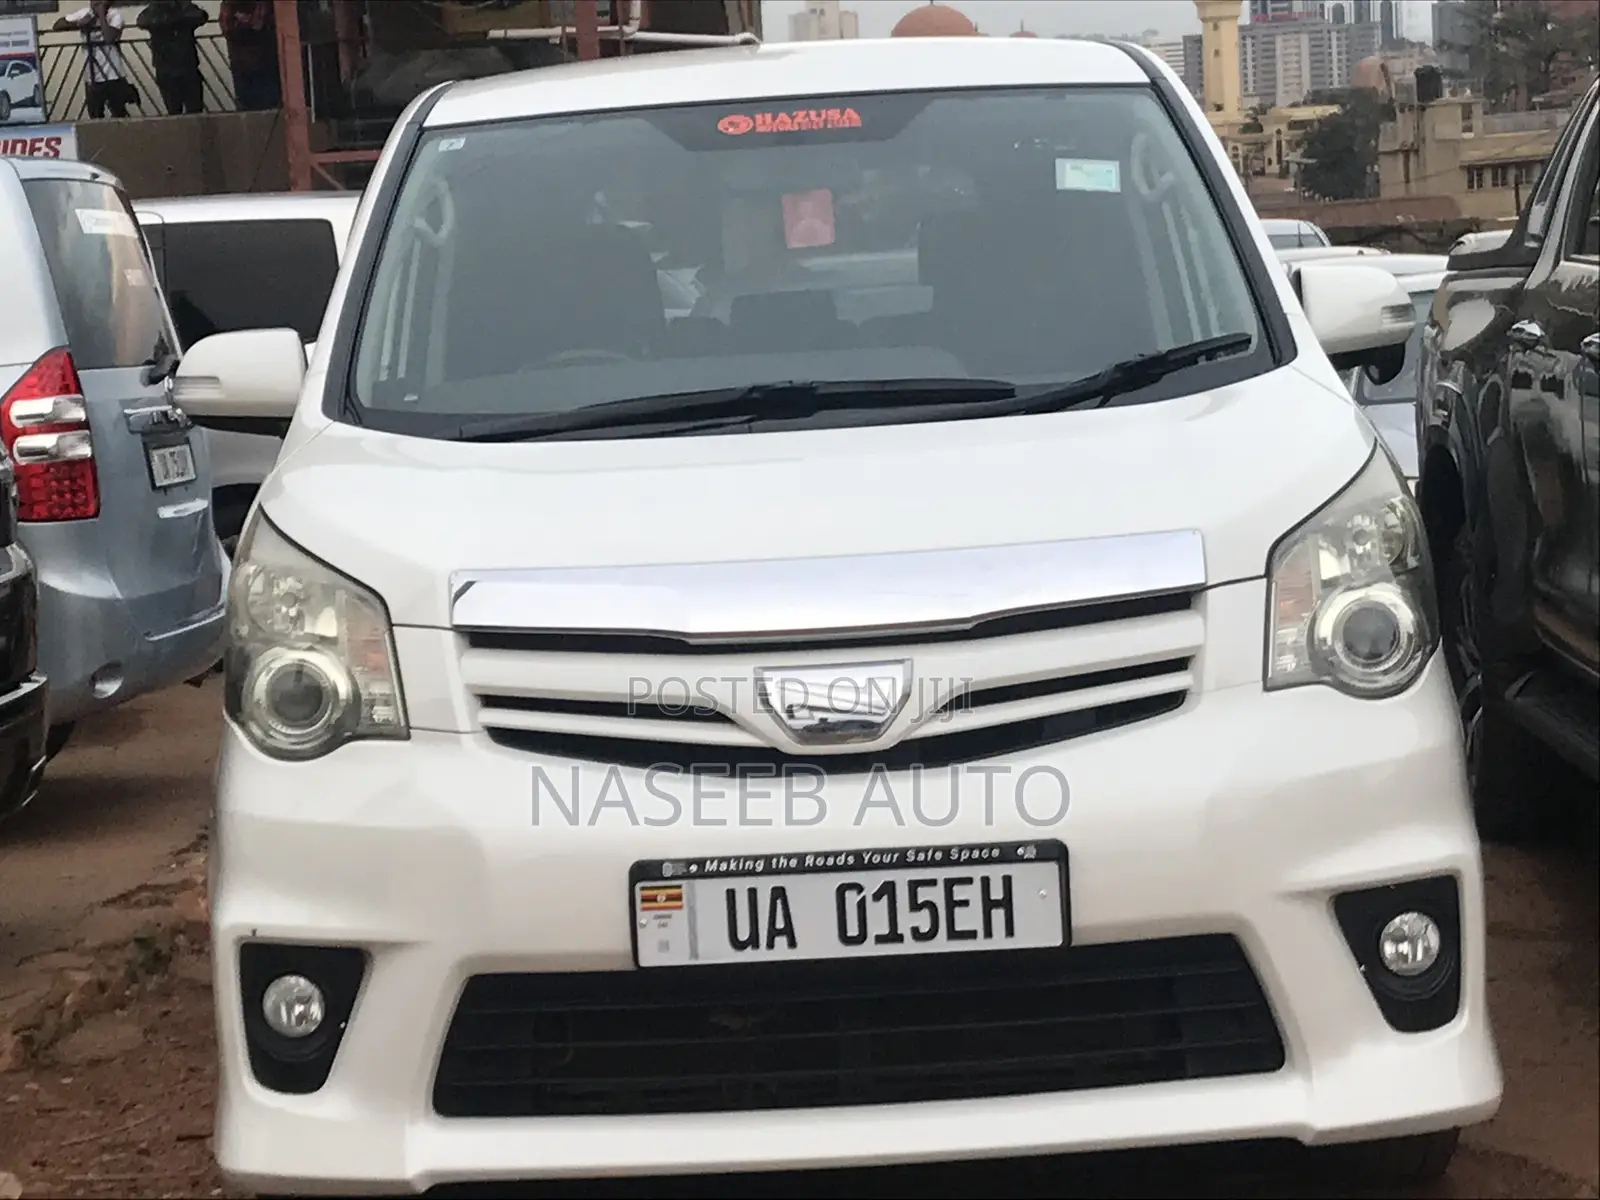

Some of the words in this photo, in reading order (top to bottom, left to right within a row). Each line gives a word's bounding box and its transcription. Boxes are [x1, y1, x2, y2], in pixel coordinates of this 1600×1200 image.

[0, 137, 61, 157] IDES
[704, 857, 764, 873] Making
[771, 855, 799, 869] the
[804, 852, 855, 868] Roads
[862, 850, 900, 865] Your
[906, 848, 943, 863] Safe
[949, 846, 1001, 862] Space
[724, 885, 798, 951] UA
[835, 874, 1016, 947] 015EH
